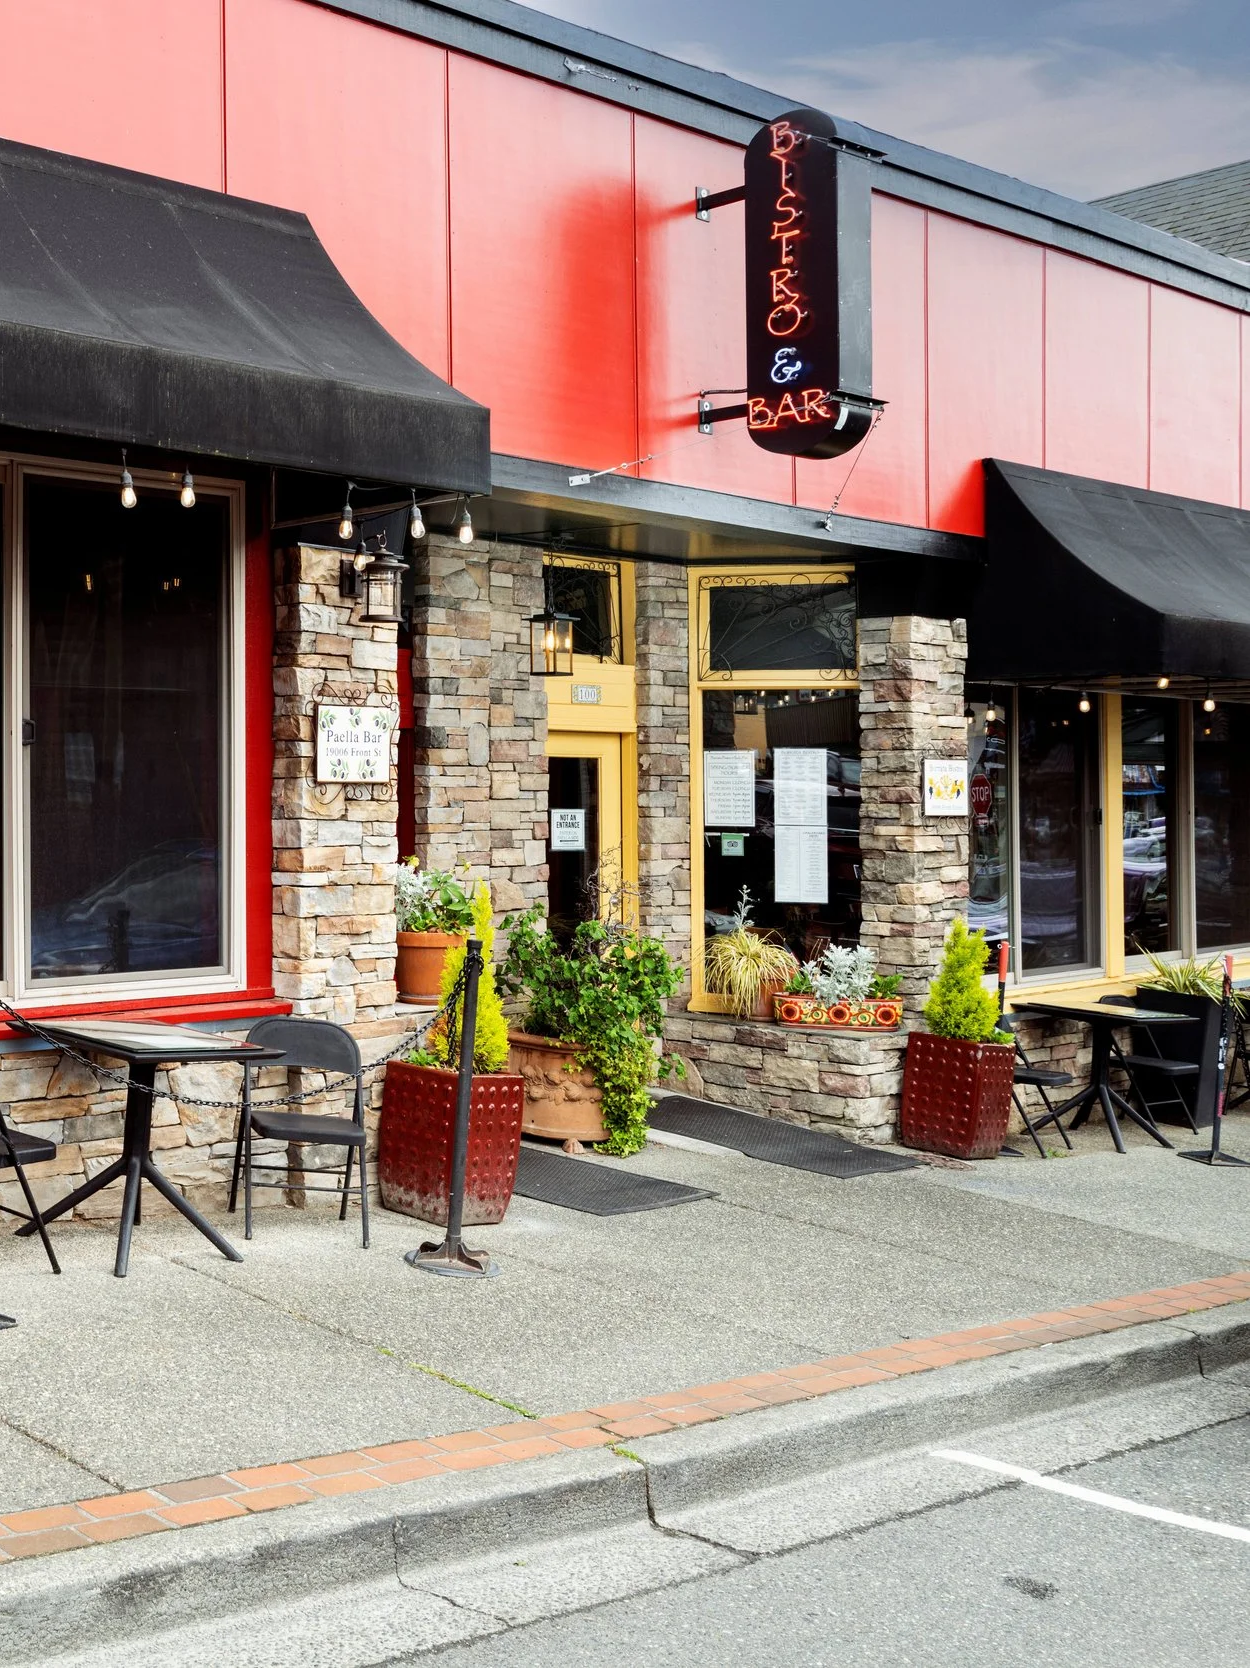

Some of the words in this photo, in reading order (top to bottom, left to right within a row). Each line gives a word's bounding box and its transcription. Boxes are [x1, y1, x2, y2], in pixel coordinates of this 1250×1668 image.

[768, 121, 801, 335] BISTRO
[770, 347, 802, 384] &
[748, 389, 831, 429] BAR
[580, 689, 596, 700] 100
[327, 729, 359, 743] Paella
[363, 731, 382, 744] Bar
[326, 747, 348, 757] 19006
[351, 748, 371, 757] Front
[374, 748, 382, 757] St
[971, 786, 990, 803] STOP
[556, 821, 580, 829] ENTRANCE
